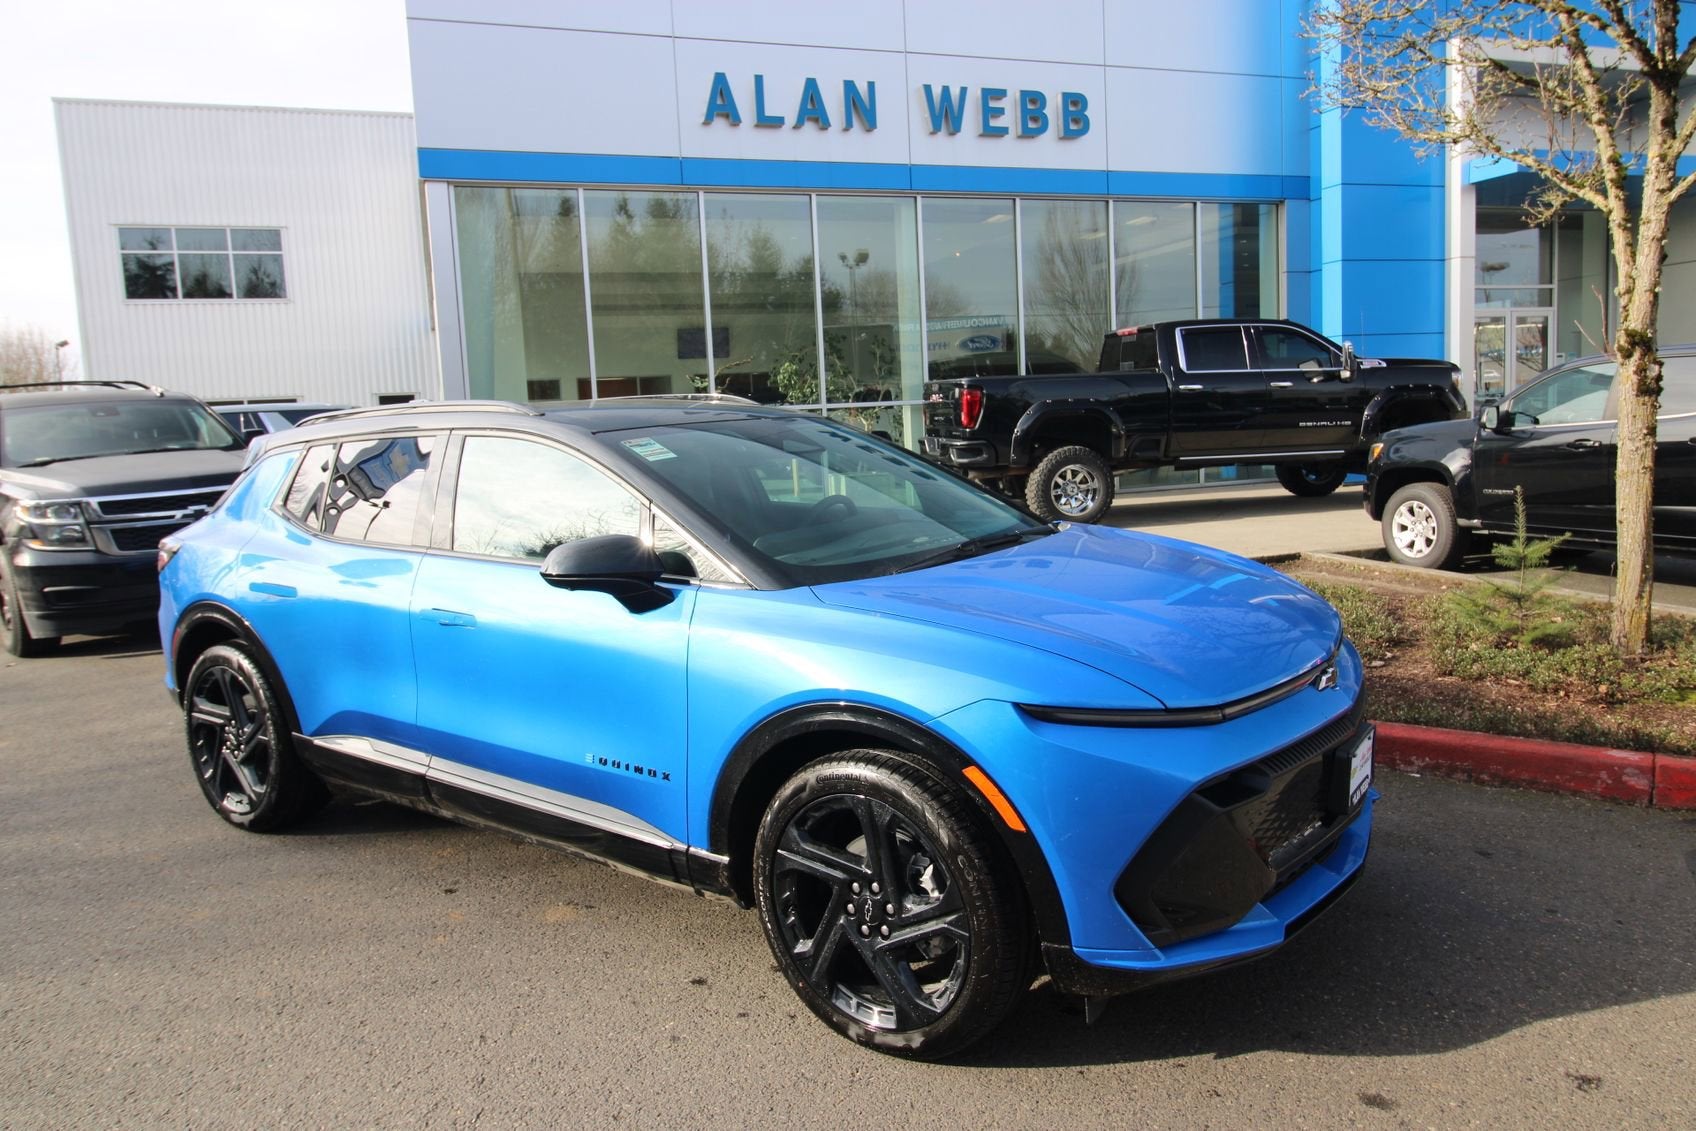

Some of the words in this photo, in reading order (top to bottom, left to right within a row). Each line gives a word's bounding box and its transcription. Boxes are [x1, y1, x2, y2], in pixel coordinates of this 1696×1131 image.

[702, 72, 878, 132] ALAN
[922, 84, 1091, 139] WEBB
[584, 752, 671, 781] EQUINOX
